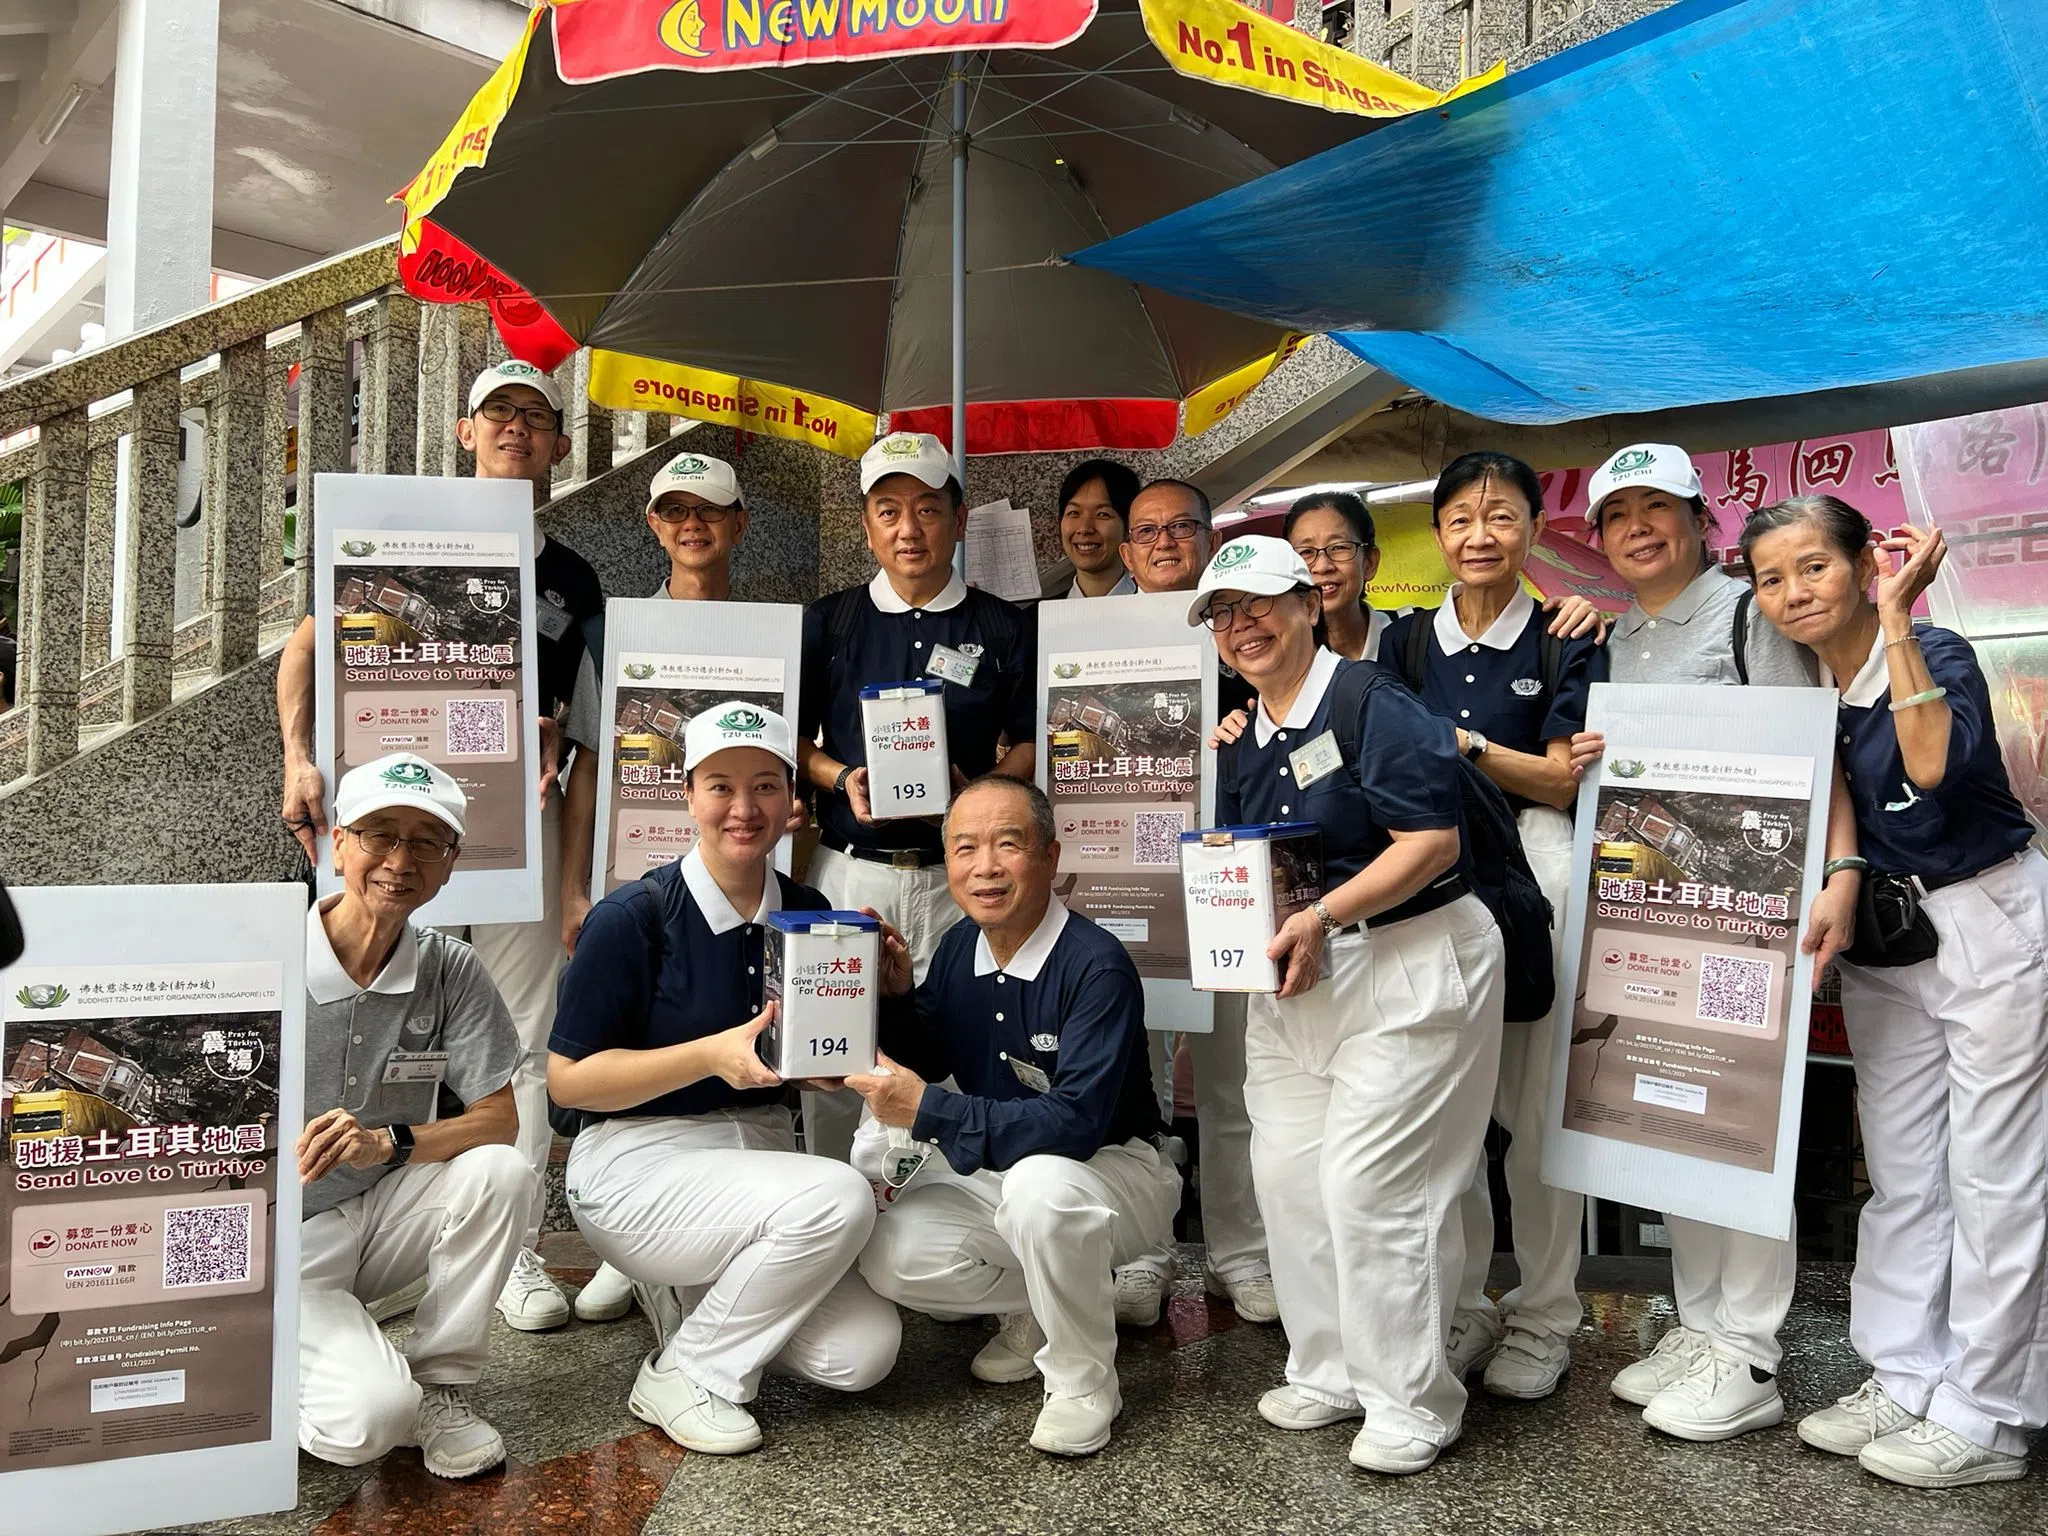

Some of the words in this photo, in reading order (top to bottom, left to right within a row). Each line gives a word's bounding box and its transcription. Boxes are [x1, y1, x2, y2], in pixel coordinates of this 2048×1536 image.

[1178, 20, 1256, 70] No.1
[1263, 46, 1297, 82] in
[1612, 473, 1630, 483] TZU
[1634, 469, 1652, 477] CHI
[1214, 569, 1231, 580] TZU
[1234, 563, 1252, 572] CHI
[1365, 582, 1450, 594] NewMoonS
[345, 641, 514, 666] 驰援土耳其地震
[346, 668, 387, 681] Send
[391, 668, 430, 681] Love
[434, 669, 450, 681] to
[455, 667, 515, 681] Türkiye
[872, 735, 889, 743] Give
[891, 734, 930, 745] Change
[879, 742, 891, 750] For
[894, 741, 936, 752] Change
[1055, 755, 1193, 780] 驰援土耳其地震
[411, 785, 431, 794] CHI
[621, 787, 656, 800] Send
[661, 788, 688, 800] Lov
[892, 783, 926, 799] 193
[1055, 782, 1087, 794] Send
[1090, 781, 1121, 793] Love
[1125, 781, 1139, 793] to
[1142, 780, 1194, 793] Türkiye
[1763, 812, 1778, 821] Pray
[1762, 820, 1789, 828] Türkiye
[1188, 886, 1206, 895] Give
[1208, 887, 1249, 898] Change
[1599, 878, 1789, 920] 驰援土耳其地震
[1195, 896, 1208, 904] For
[1210, 896, 1255, 909] Change
[1598, 903, 1641, 921] Send
[1646, 906, 1688, 926] Love
[1692, 914, 1710, 928] to
[1716, 916, 1788, 939] Türkiye
[1209, 949, 1244, 968] 197
[1628, 952, 1693, 970] 募您一份爱心
[796, 957, 863, 975] 小钱行大善
[1627, 963, 1659, 975] DONATE
[1660, 967, 1680, 977] NOW
[79, 978, 216, 994] 佛教慈济功德会(新加坡)
[791, 977, 812, 987] Give
[814, 978, 861, 989] Change
[1626, 984, 1660, 995] PAYNOW
[167, 993, 216, 1001] ORGANIZATION
[218, 991, 262, 999] (SINGAPORE)
[799, 986, 814, 995] For
[816, 985, 865, 998] Change
[228, 1031, 246, 1040] Pray
[227, 1039, 259, 1047] Türkiye
[809, 1037, 848, 1056] 194
[1658, 1038, 1690, 1050] Fundraising
[1702, 1045, 1716, 1054] Page
[1662, 1061, 1693, 1073] Fundraising
[16, 1124, 266, 1168] 驰援土耳其地震
[16, 1172, 77, 1190] Send
[85, 1168, 141, 1185] Love
[149, 1165, 172, 1181] to
[179, 1159, 266, 1178] Türkiye
[66, 1223, 152, 1240] 募您一份爱心
[65, 1240, 109, 1252] DONATE
[111, 1238, 138, 1247] NOW
[67, 1266, 113, 1277] PAYNOW
[117, 1264, 136, 1274] 捐款
[65, 1281, 84, 1290] UEN
[85, 1277, 135, 1288] 201611166R
[117, 1322, 159, 1334] Fundraising
[174, 1319, 192, 1328] Page
[140, 1331, 156, 1340] (EN)
[157, 1325, 217, 1338] bit.ly/2023TUR_en
[125, 1348, 165, 1360] Fundraising
[165, 1346, 188, 1355] Permit
[121, 1358, 156, 1368] 0011/2023
